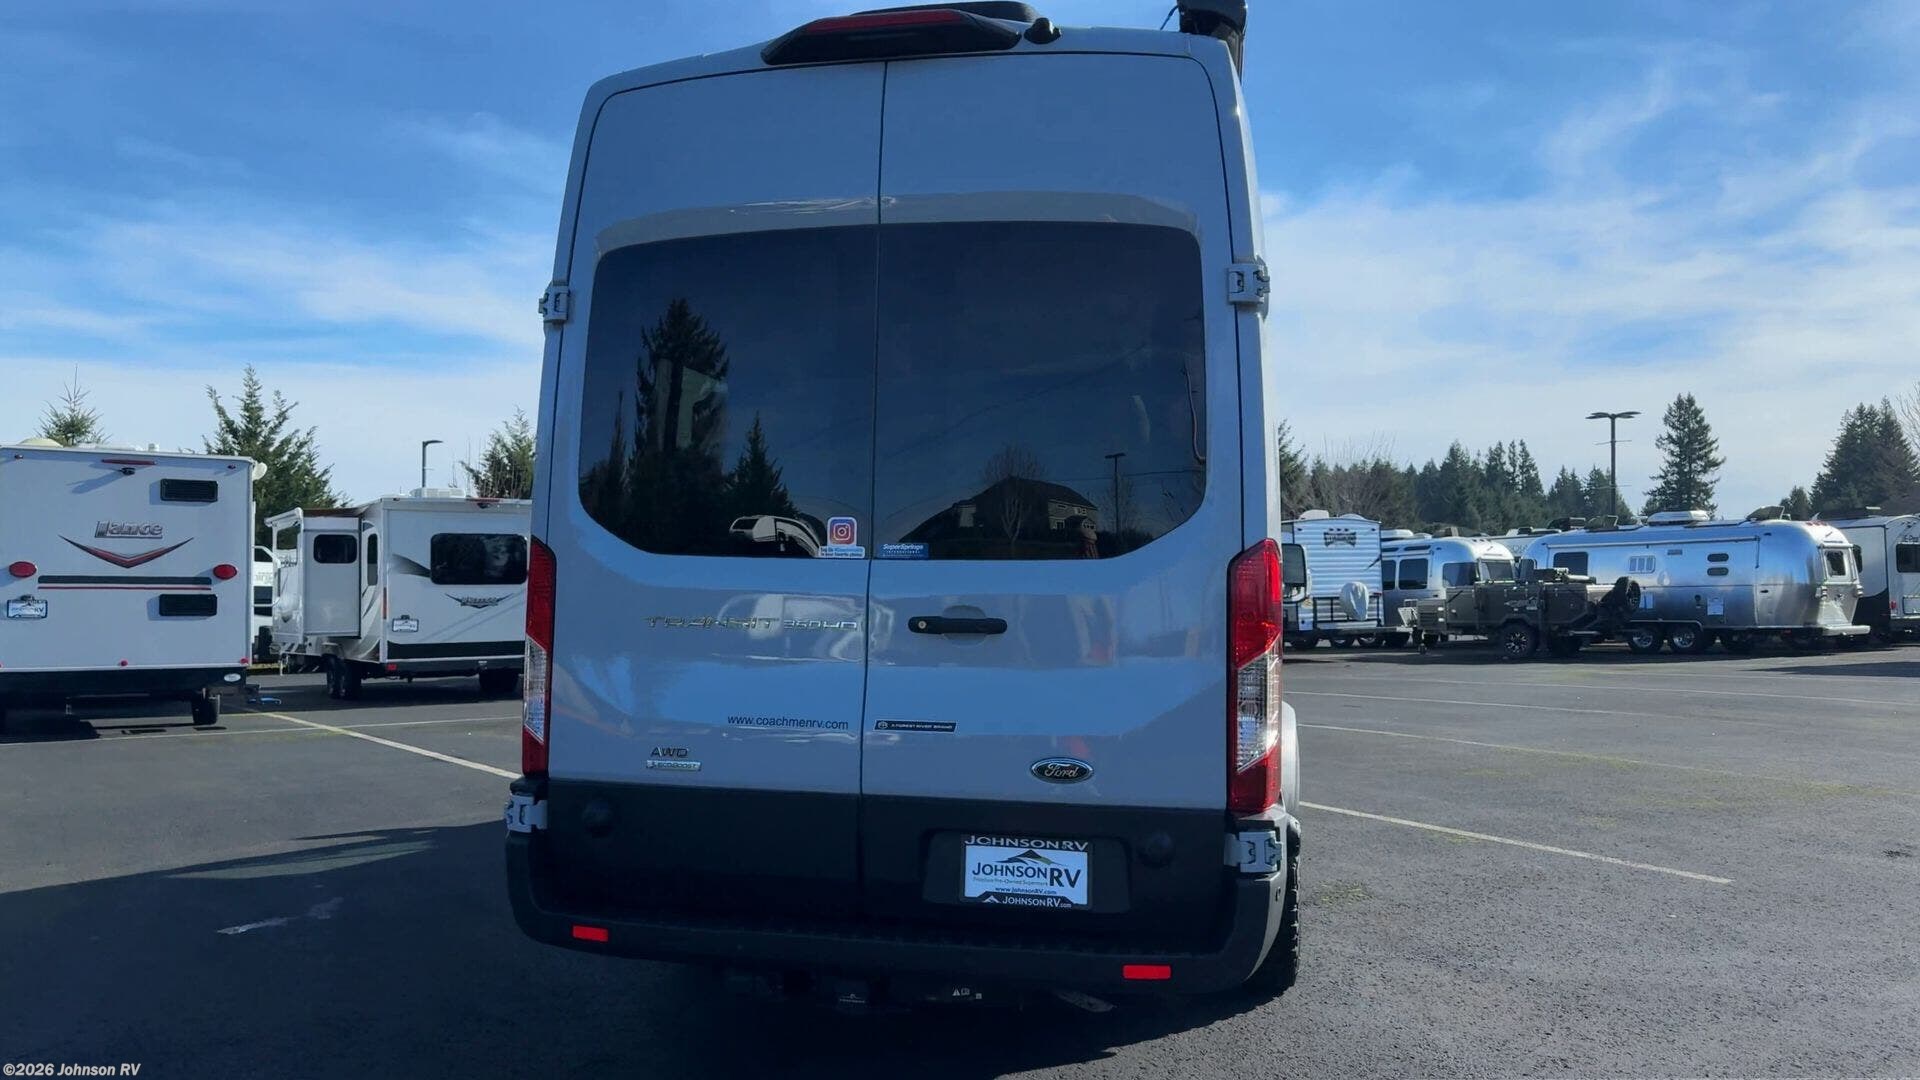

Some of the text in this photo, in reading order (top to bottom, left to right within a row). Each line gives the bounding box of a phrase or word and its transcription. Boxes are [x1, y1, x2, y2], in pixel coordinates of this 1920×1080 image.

[95, 520, 163, 539] Lance
[727, 715, 849, 730] www.coachmenrv.com
[650, 746, 688, 758] AWD
[1044, 763, 1080, 777] Ford
